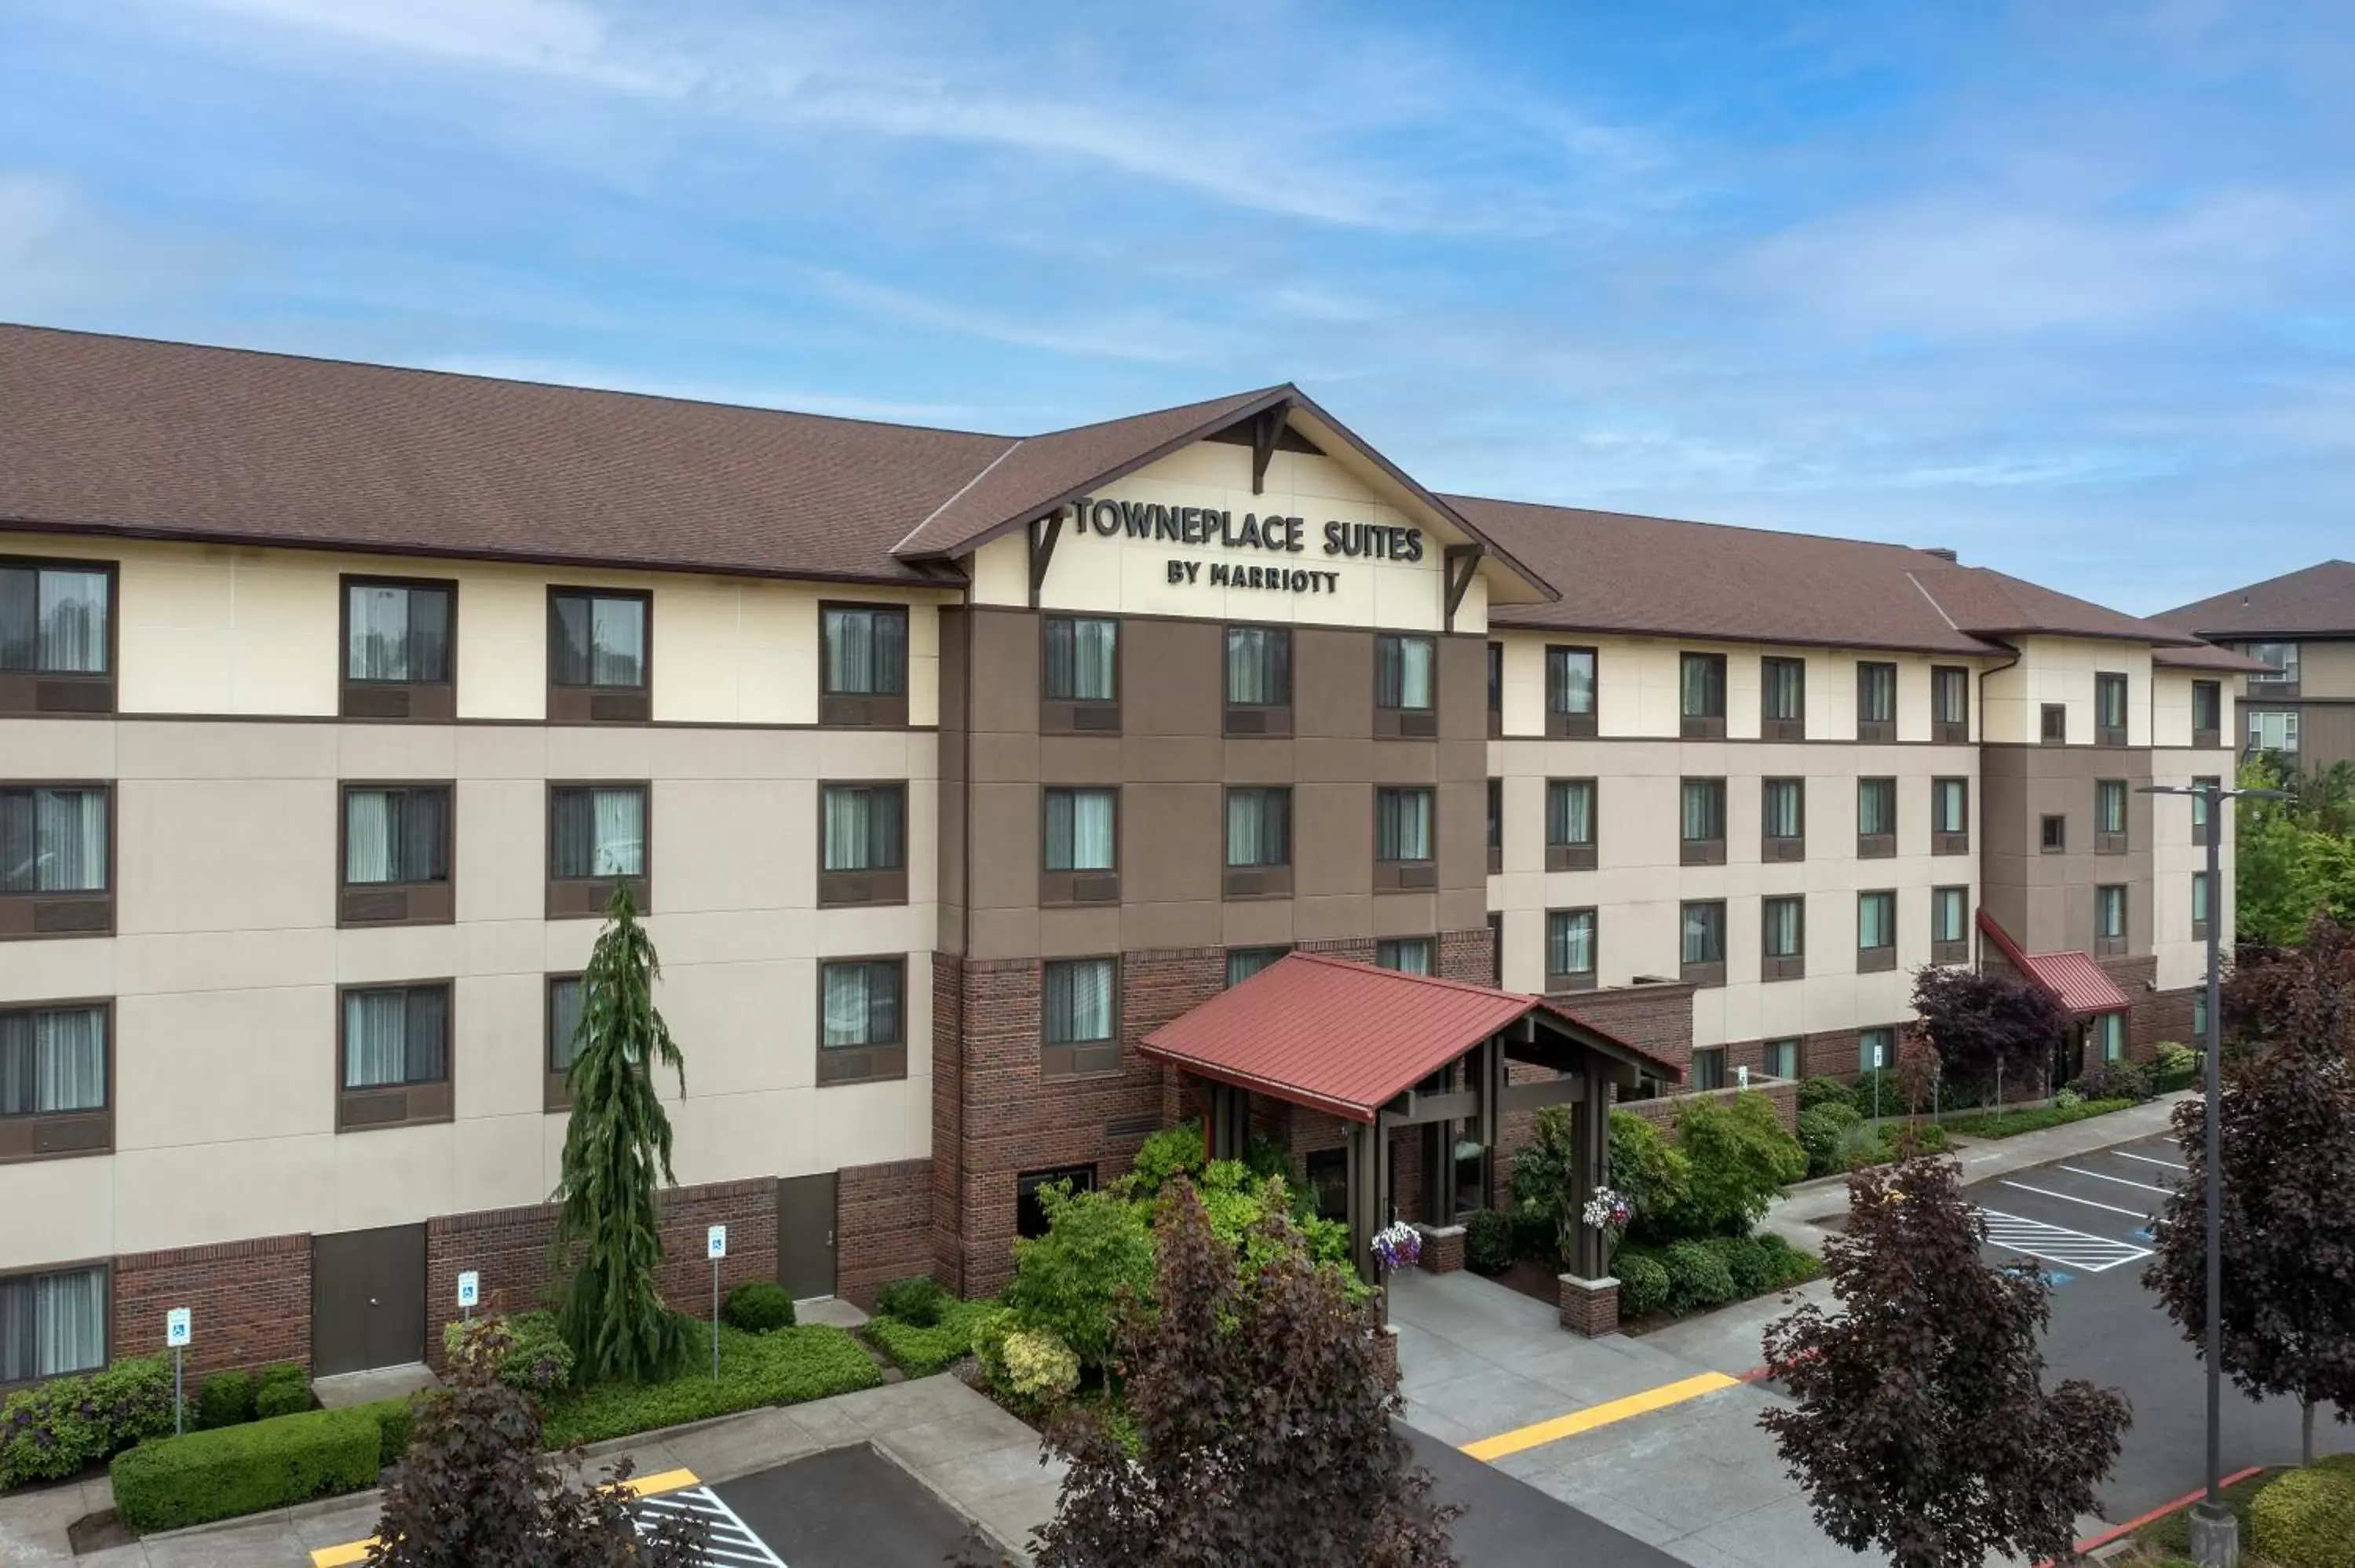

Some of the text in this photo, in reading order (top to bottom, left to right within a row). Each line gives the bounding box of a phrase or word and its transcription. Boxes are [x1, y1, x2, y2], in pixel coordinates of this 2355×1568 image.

[1072, 497, 1423, 562] TOWNEPLACE SUITES
[1167, 560, 1340, 593] BY MARRIOTT
